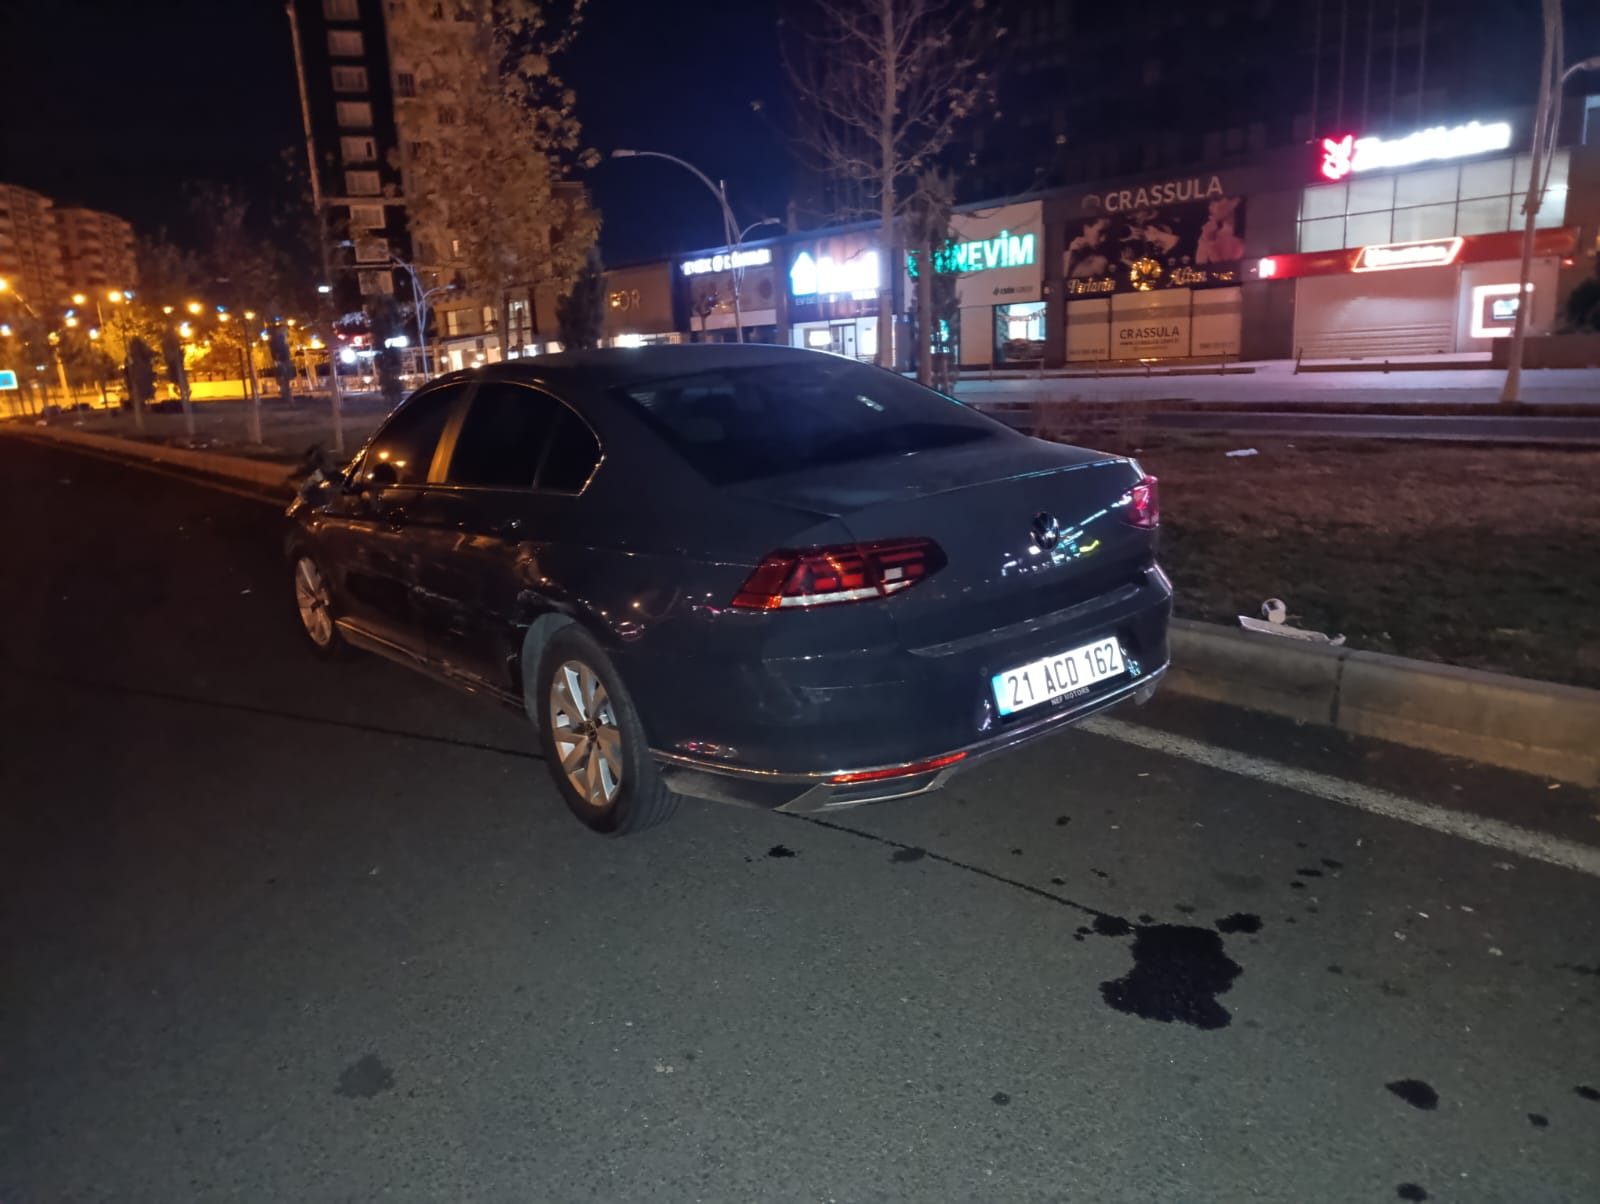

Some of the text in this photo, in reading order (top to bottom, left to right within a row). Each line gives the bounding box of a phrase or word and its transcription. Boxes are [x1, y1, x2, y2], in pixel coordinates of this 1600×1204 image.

[1105, 176, 1223, 211] CRASSULA
[1119, 326, 1180, 340] CRASSULA
[1008, 643, 1118, 706] 21 ACD 162
[1063, 687, 1090, 699] MOTORS
